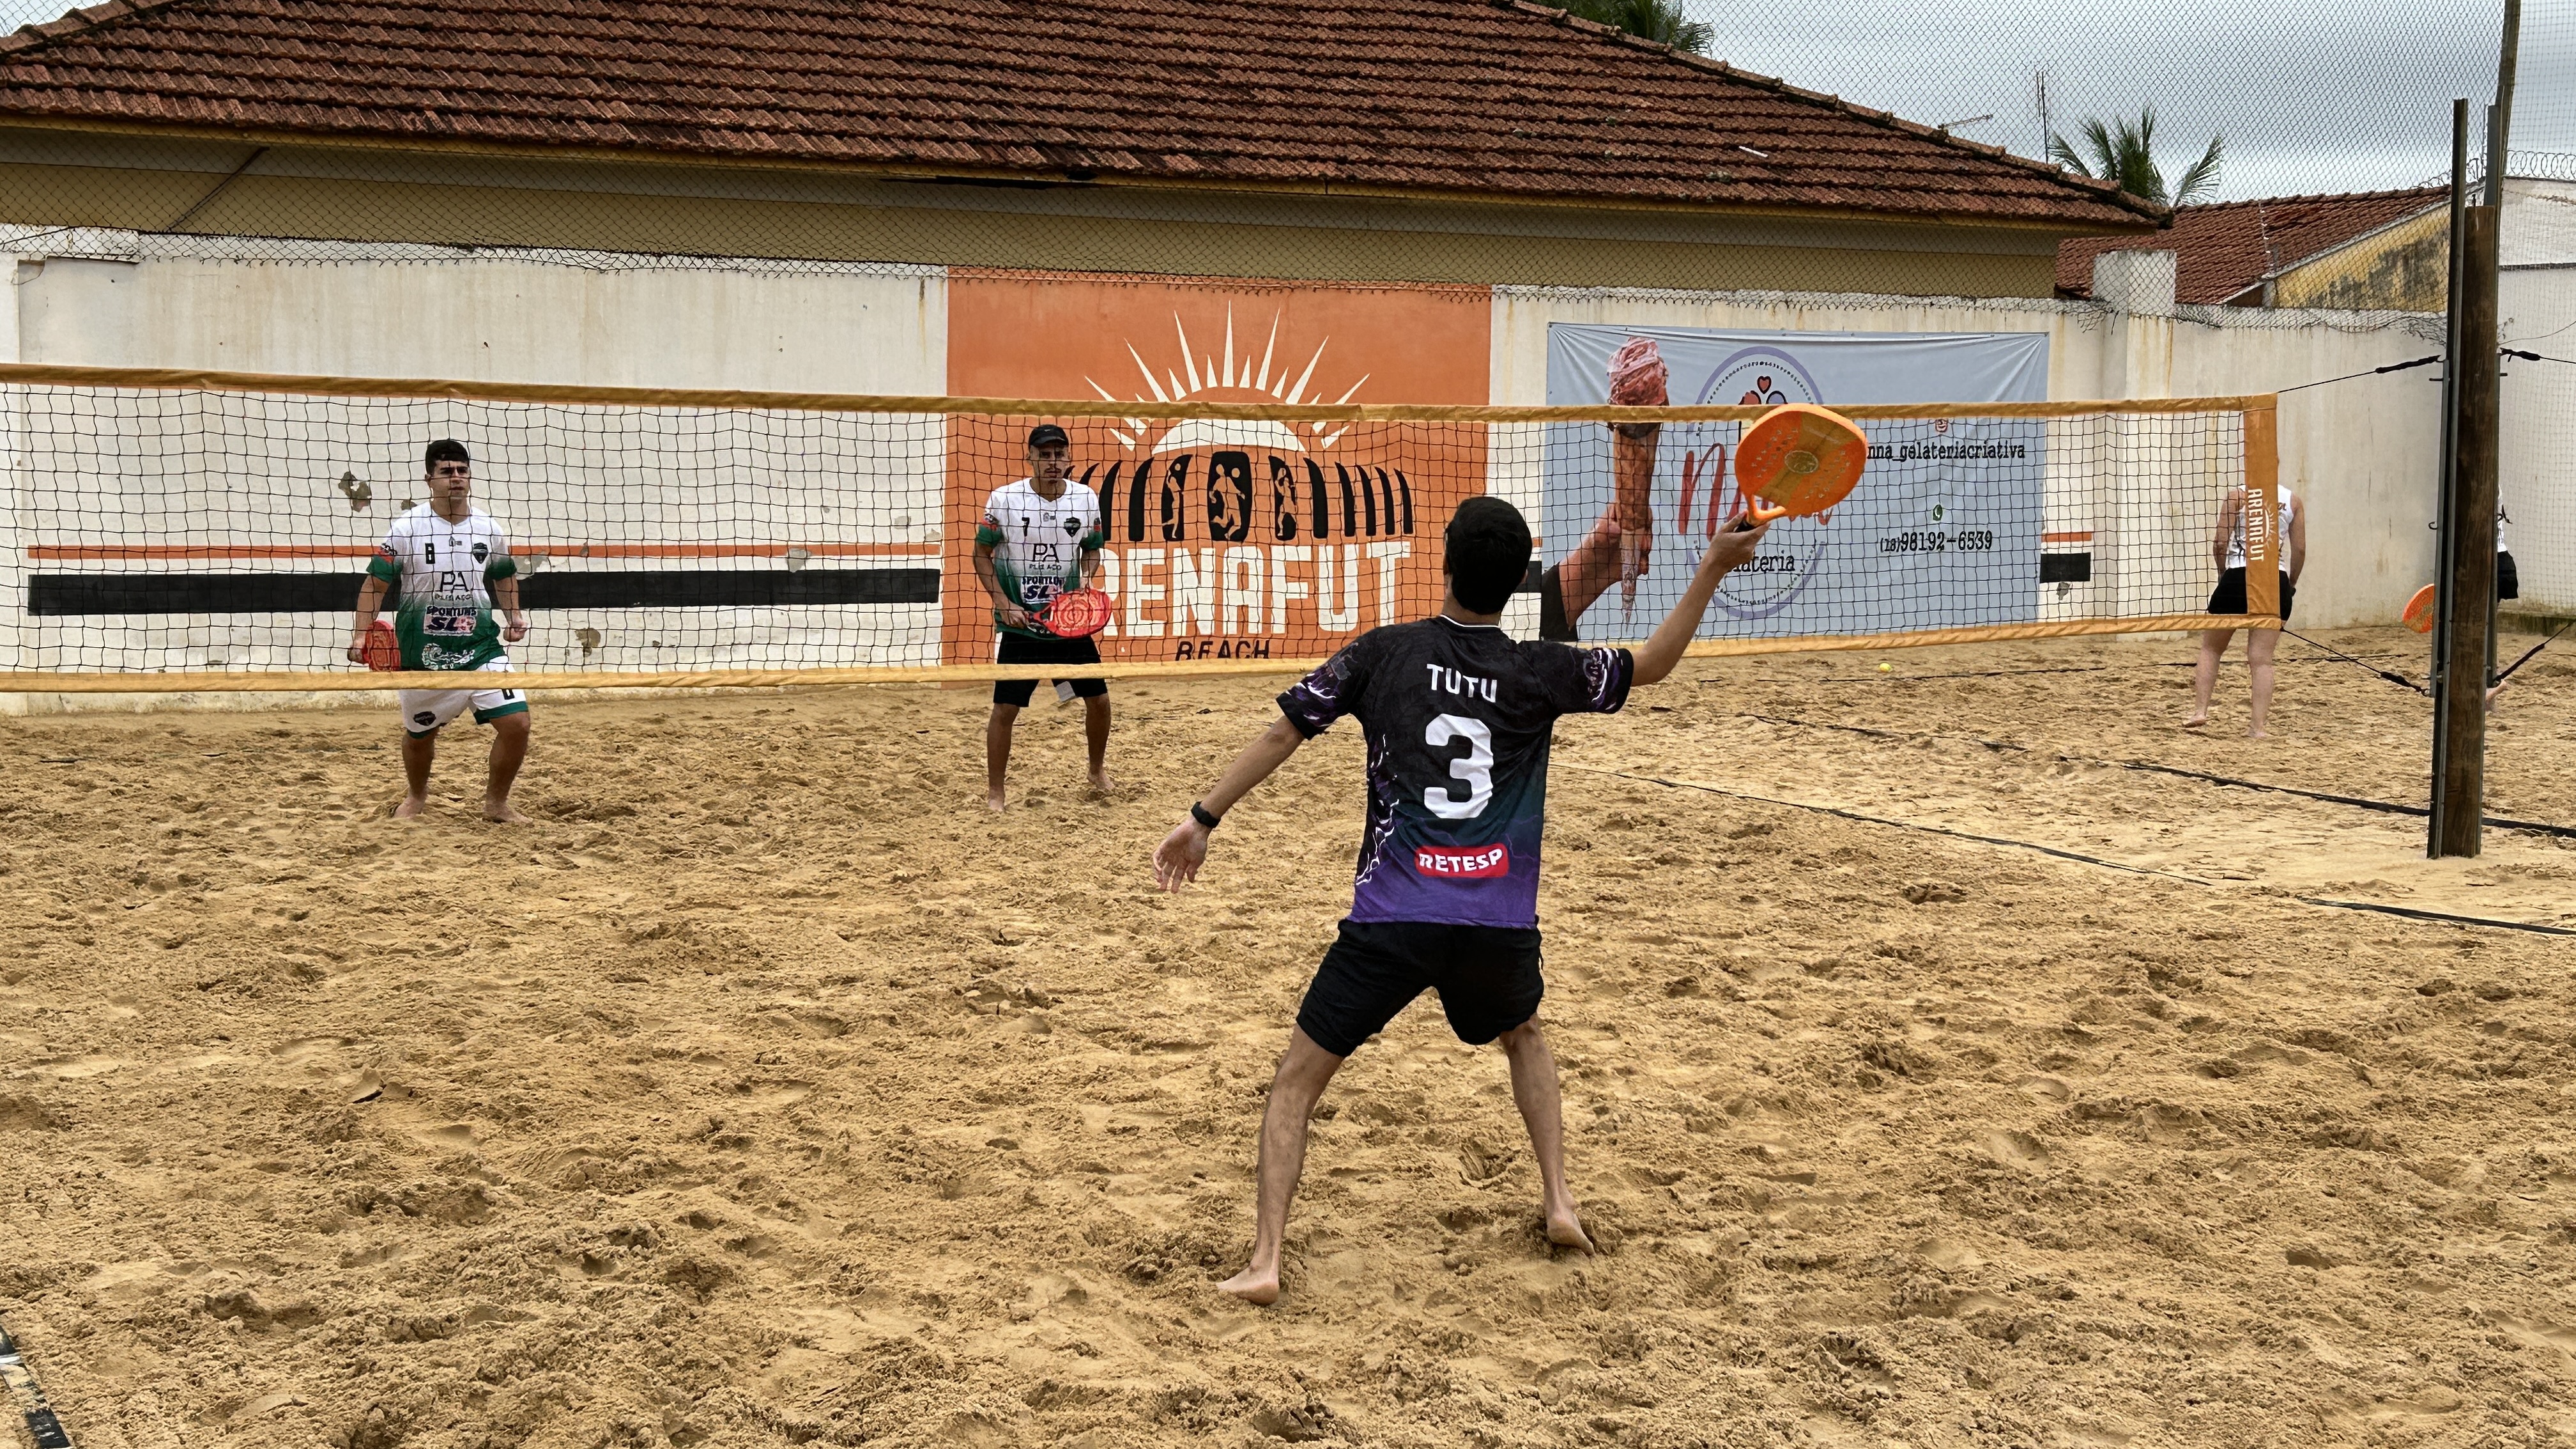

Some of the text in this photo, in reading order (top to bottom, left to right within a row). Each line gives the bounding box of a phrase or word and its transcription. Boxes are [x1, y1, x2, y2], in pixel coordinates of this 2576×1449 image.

[1867, 440, 2025, 462] nna_gelateriacriativa
[1022, 517, 1030, 537] 7
[2248, 488, 2264, 562] ARENAFUT
[1032, 543, 1059, 562] PA
[1733, 550, 1795, 572] ateria
[440, 571, 470, 592] PA
[1080, 541, 1411, 636] RENAFUT
[1176, 640, 1270, 661] BEACH
[1426, 663, 1498, 703] TUTU
[1423, 712, 1494, 819] 3
[1418, 848, 1503, 872] RETESP
